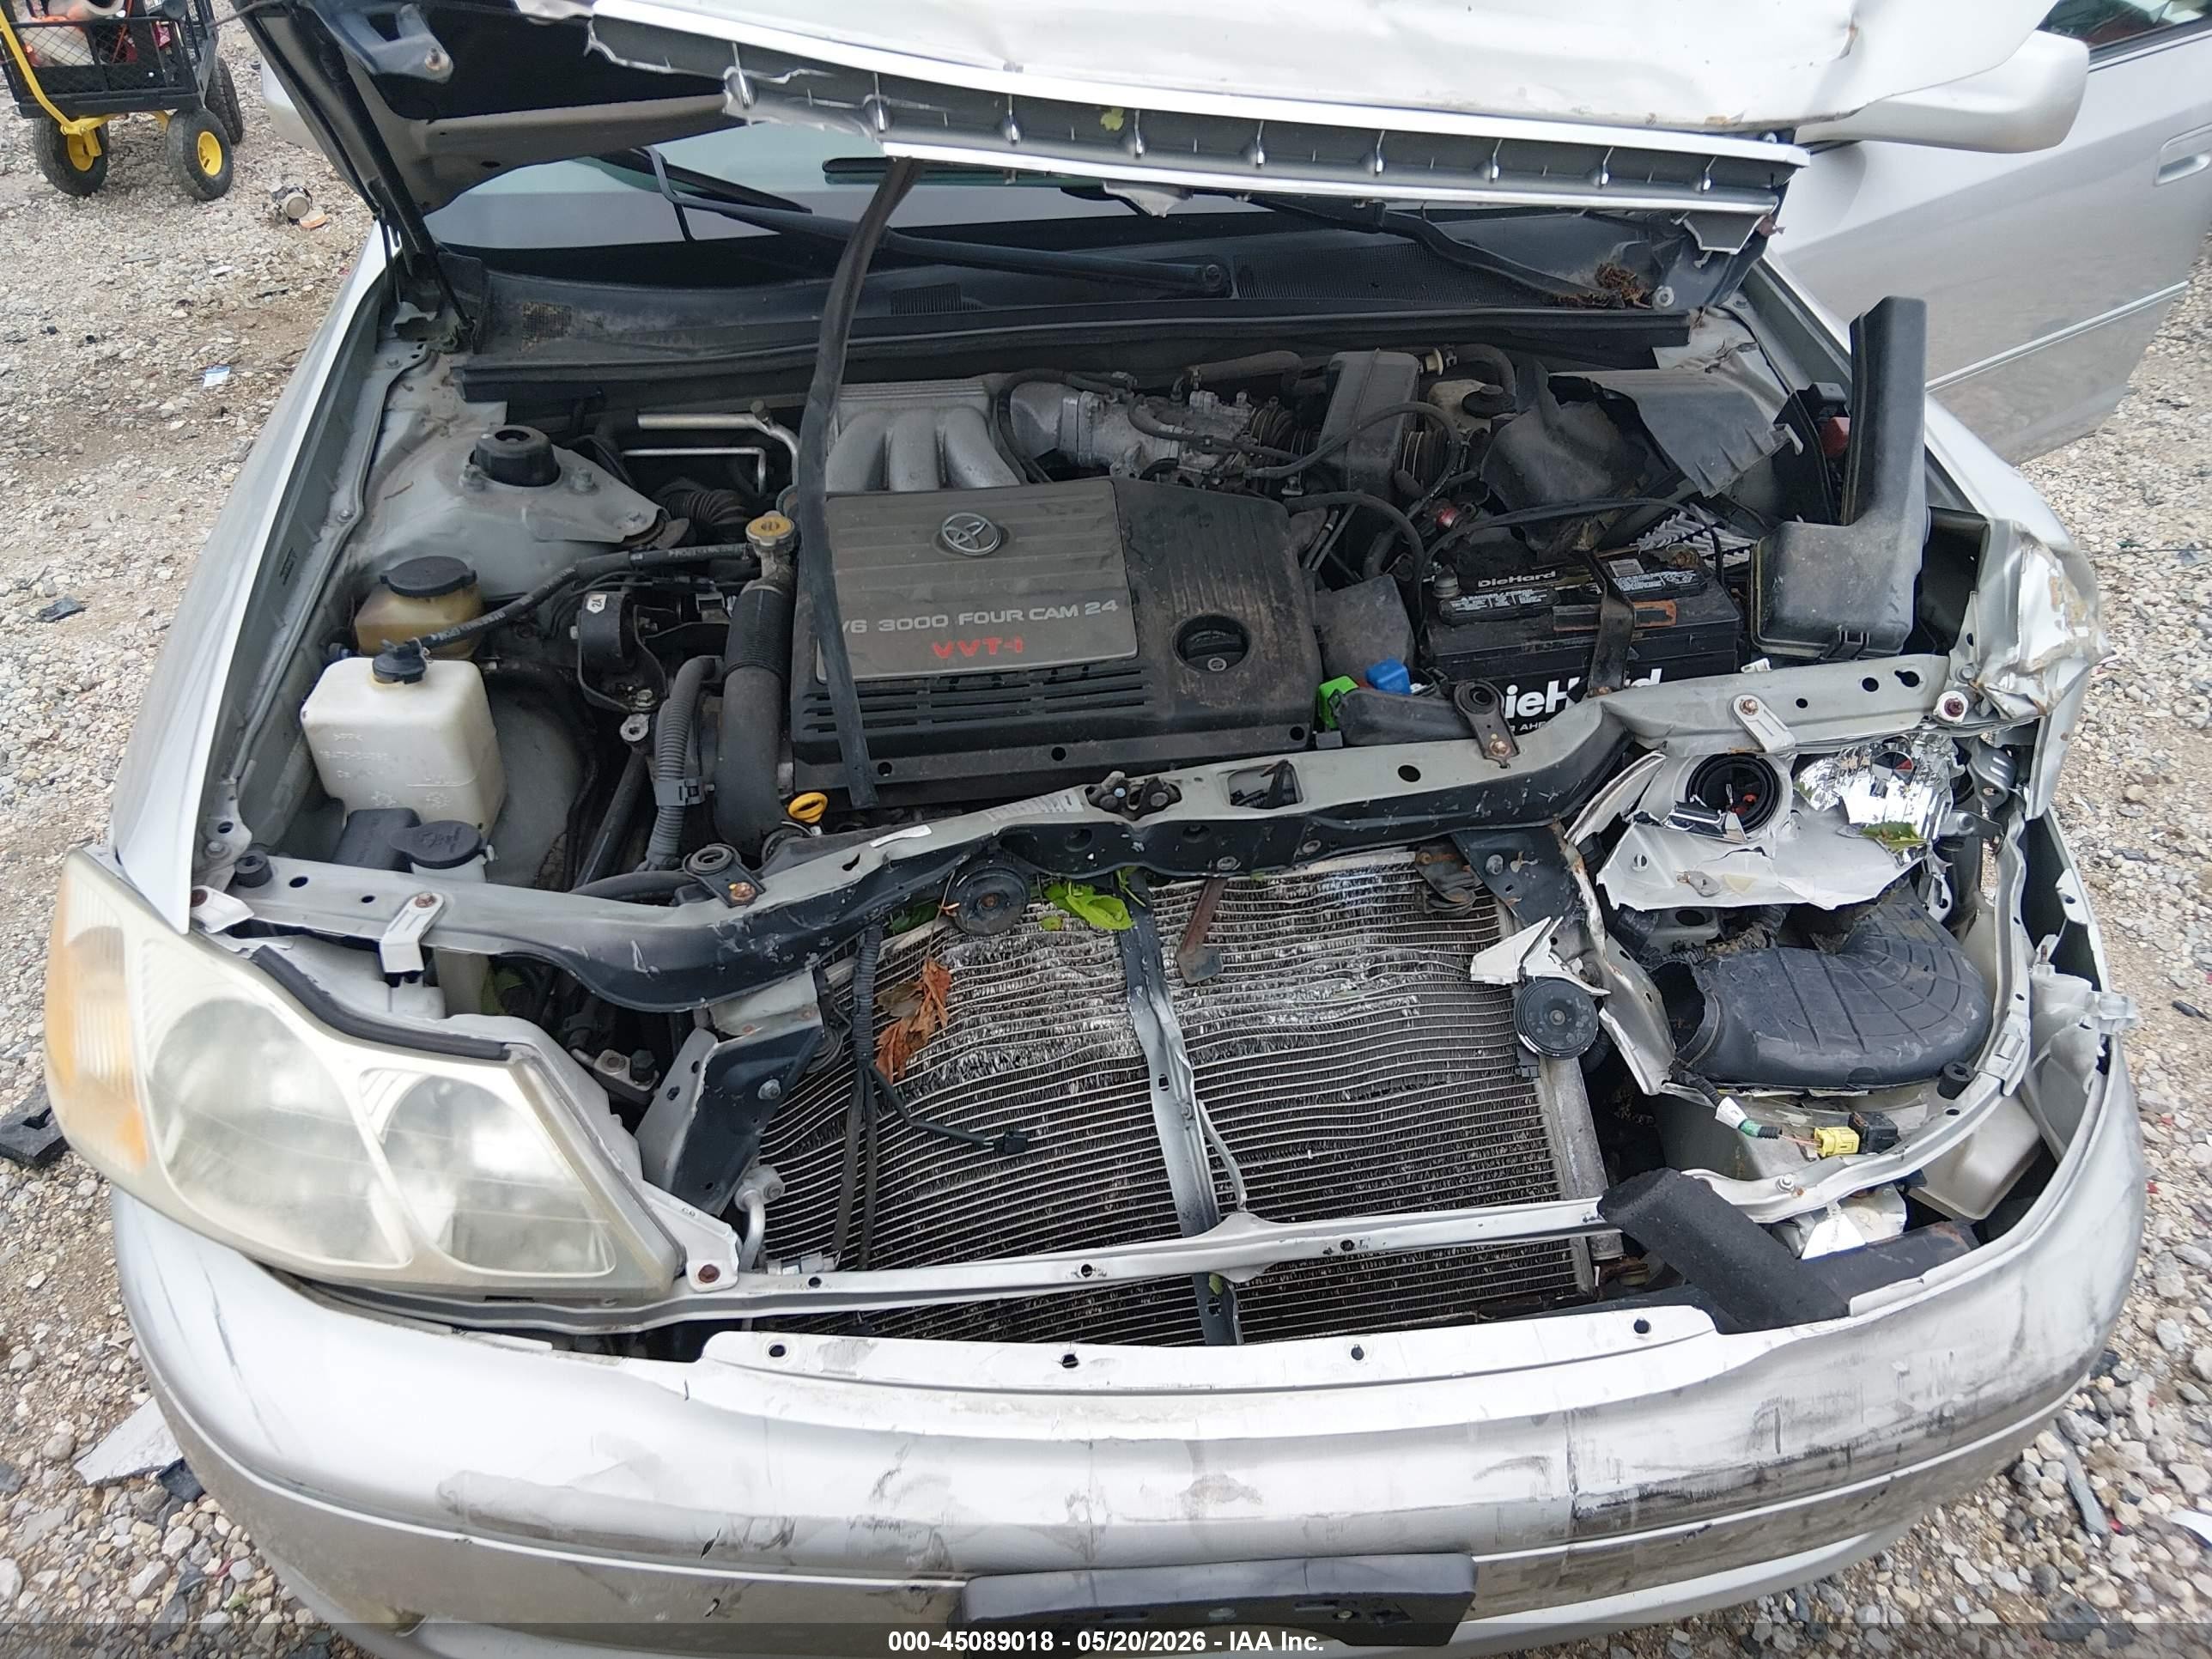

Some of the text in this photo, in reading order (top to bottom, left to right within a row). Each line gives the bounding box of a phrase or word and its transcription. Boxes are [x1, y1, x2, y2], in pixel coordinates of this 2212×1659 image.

[1478, 570, 1556, 587] DieHard
[878, 614, 949, 632] 3000
[958, 611, 1024, 626] FOUR
[1029, 604, 1079, 621] CAM
[1085, 599, 1119, 616] 24
